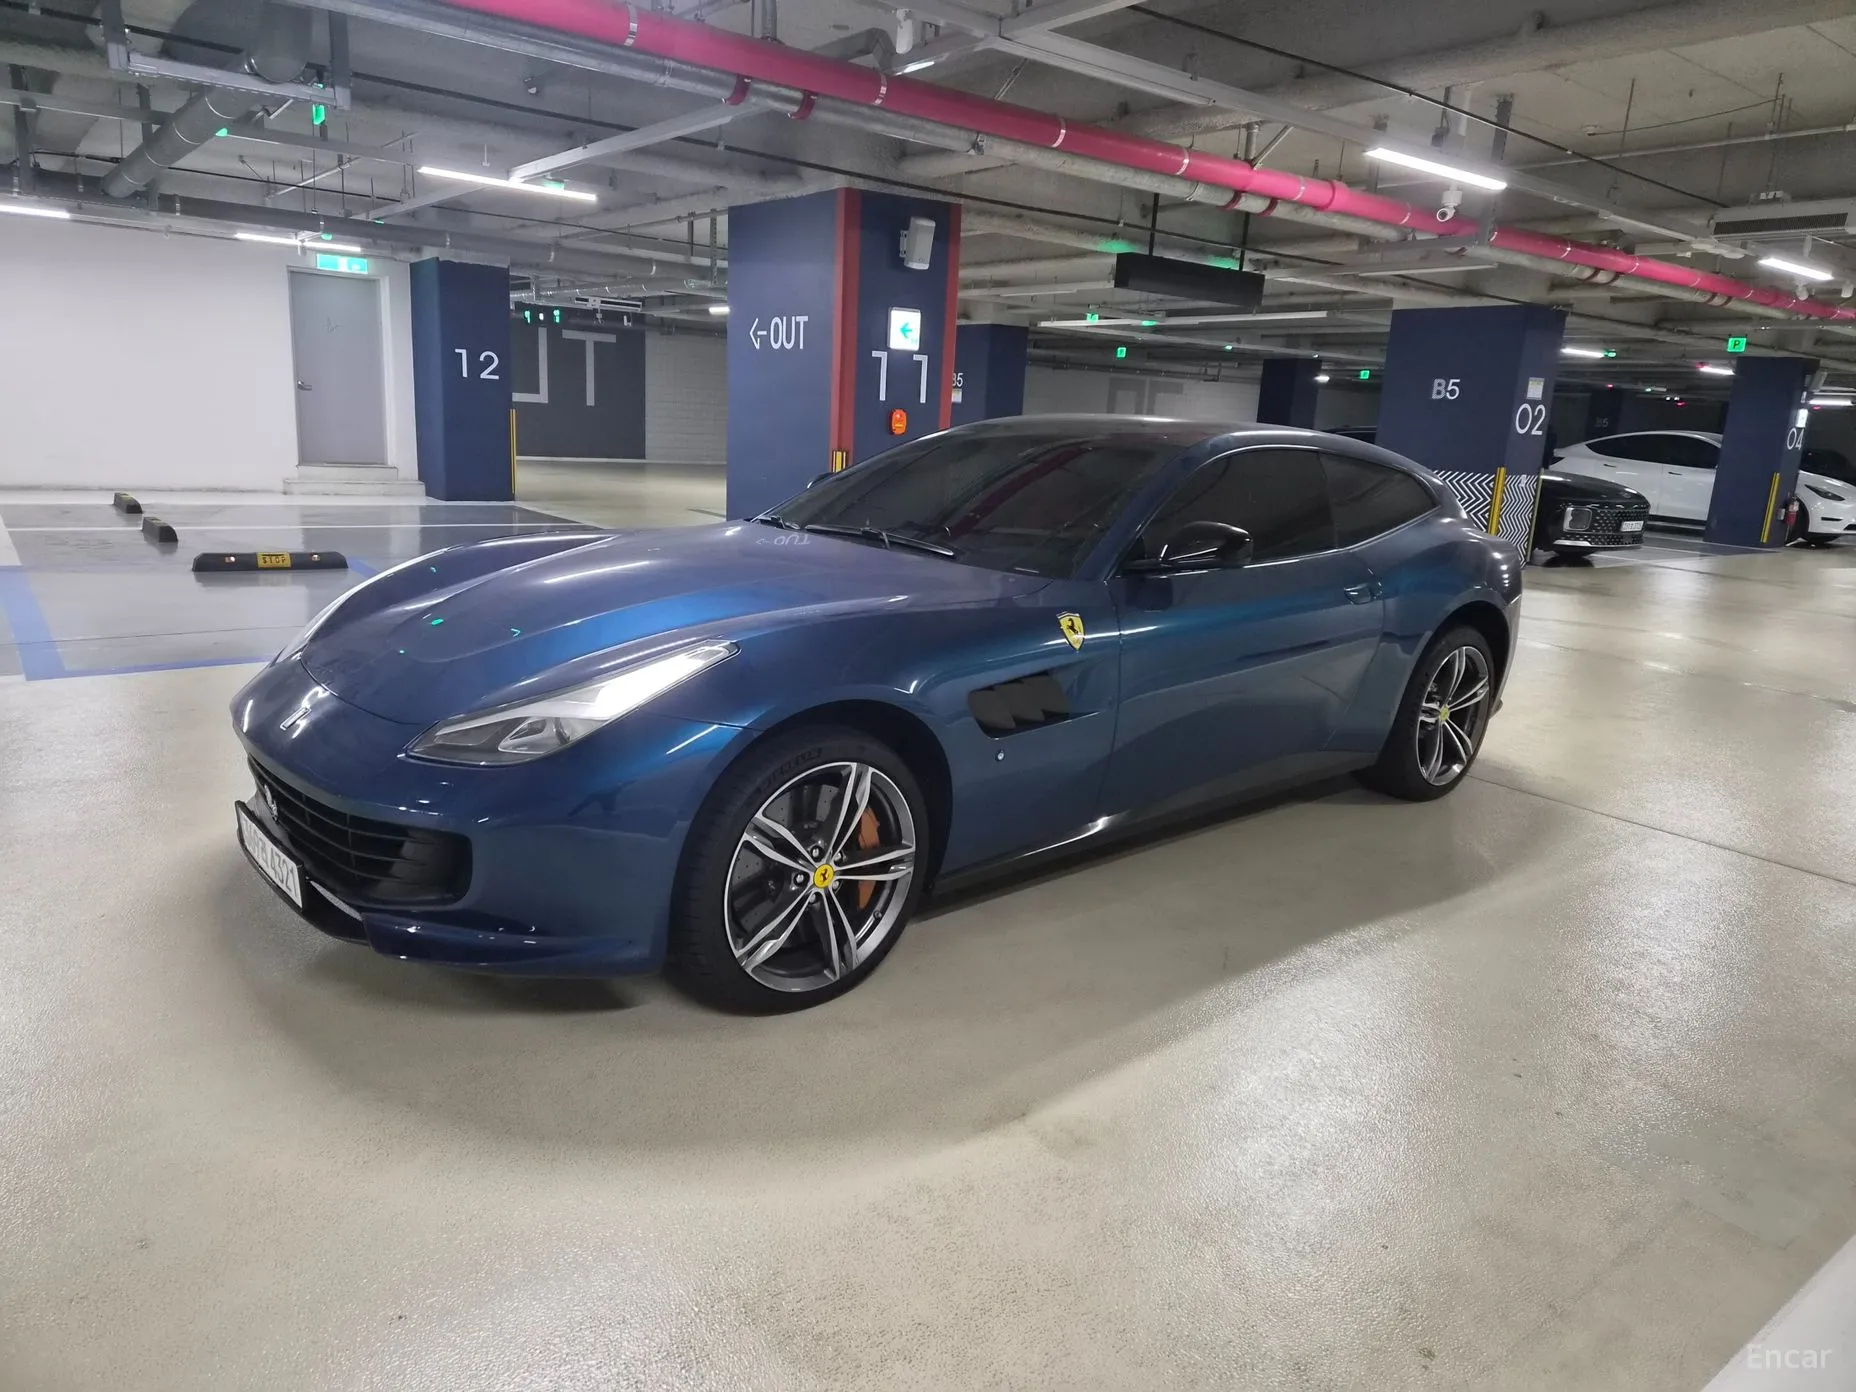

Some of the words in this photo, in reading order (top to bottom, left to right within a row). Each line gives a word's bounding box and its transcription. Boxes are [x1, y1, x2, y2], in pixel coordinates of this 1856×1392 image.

[769, 316, 809, 350] OUT
[455, 348, 500, 380] 12
[1431, 378, 1461, 400] B5
[1515, 403, 1546, 435] 02
[262, 556, 286, 564] STOP
